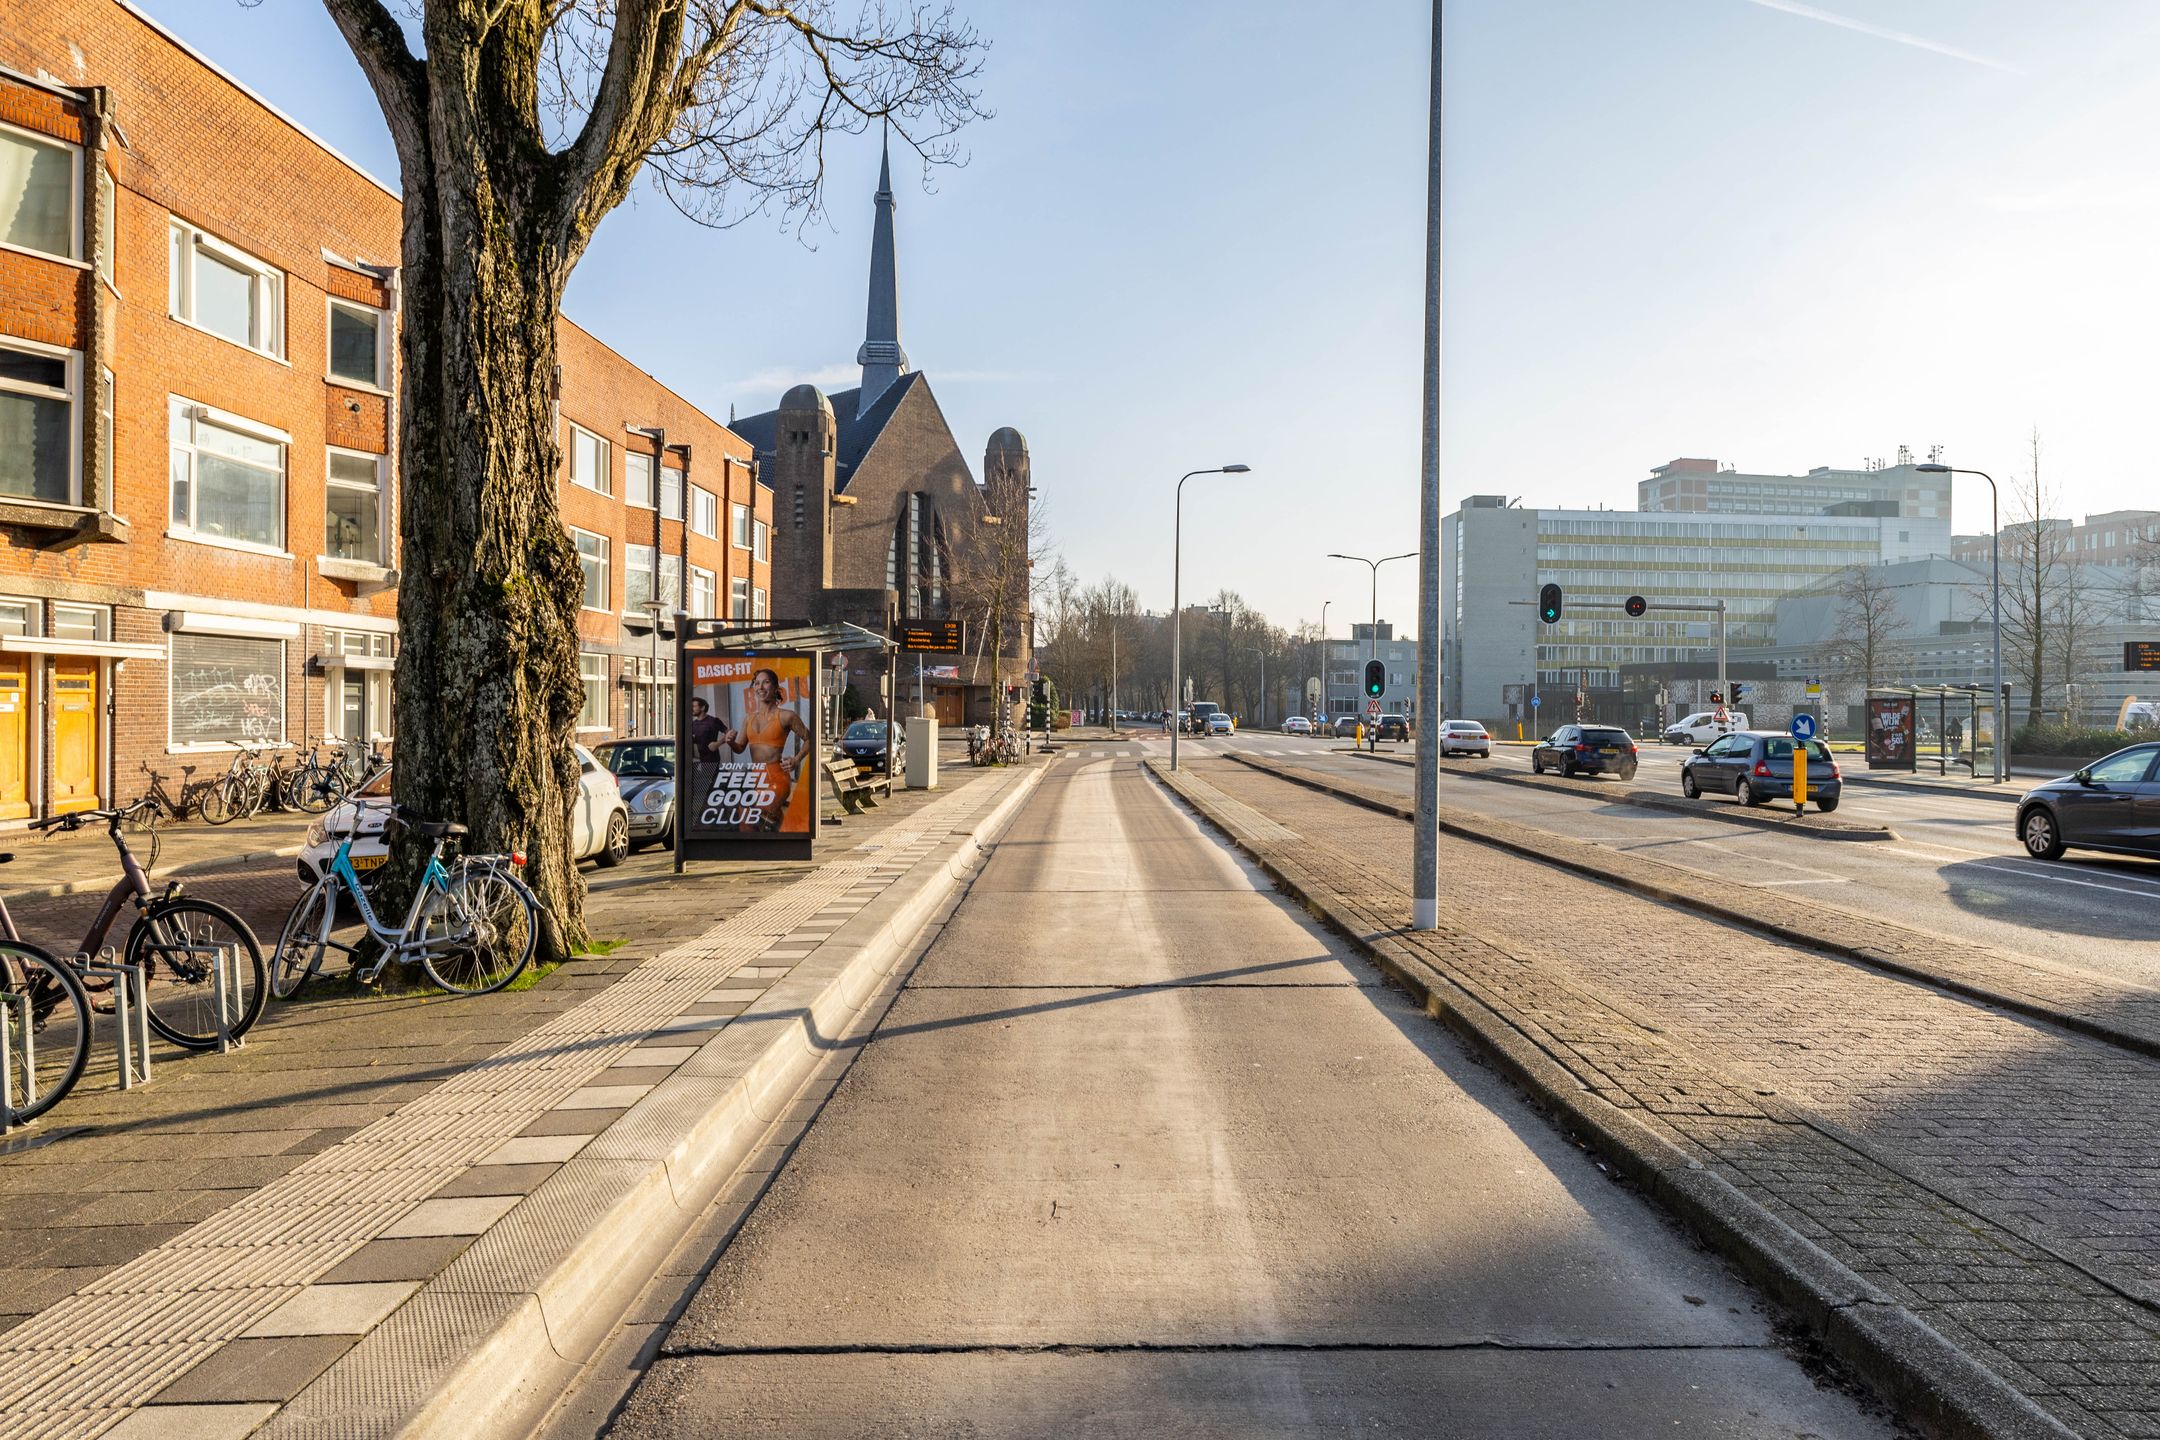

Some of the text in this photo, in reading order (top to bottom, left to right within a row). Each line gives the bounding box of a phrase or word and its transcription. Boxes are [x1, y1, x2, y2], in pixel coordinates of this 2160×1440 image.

[697, 661, 752, 679] BASIC-FIT
[719, 762, 767, 771] JOIN THE
[713, 771, 770, 789] FEEL
[707, 789, 776, 807] GOOD
[700, 807, 762, 825] CLUB
[355, 883, 374, 922] Gazelle
